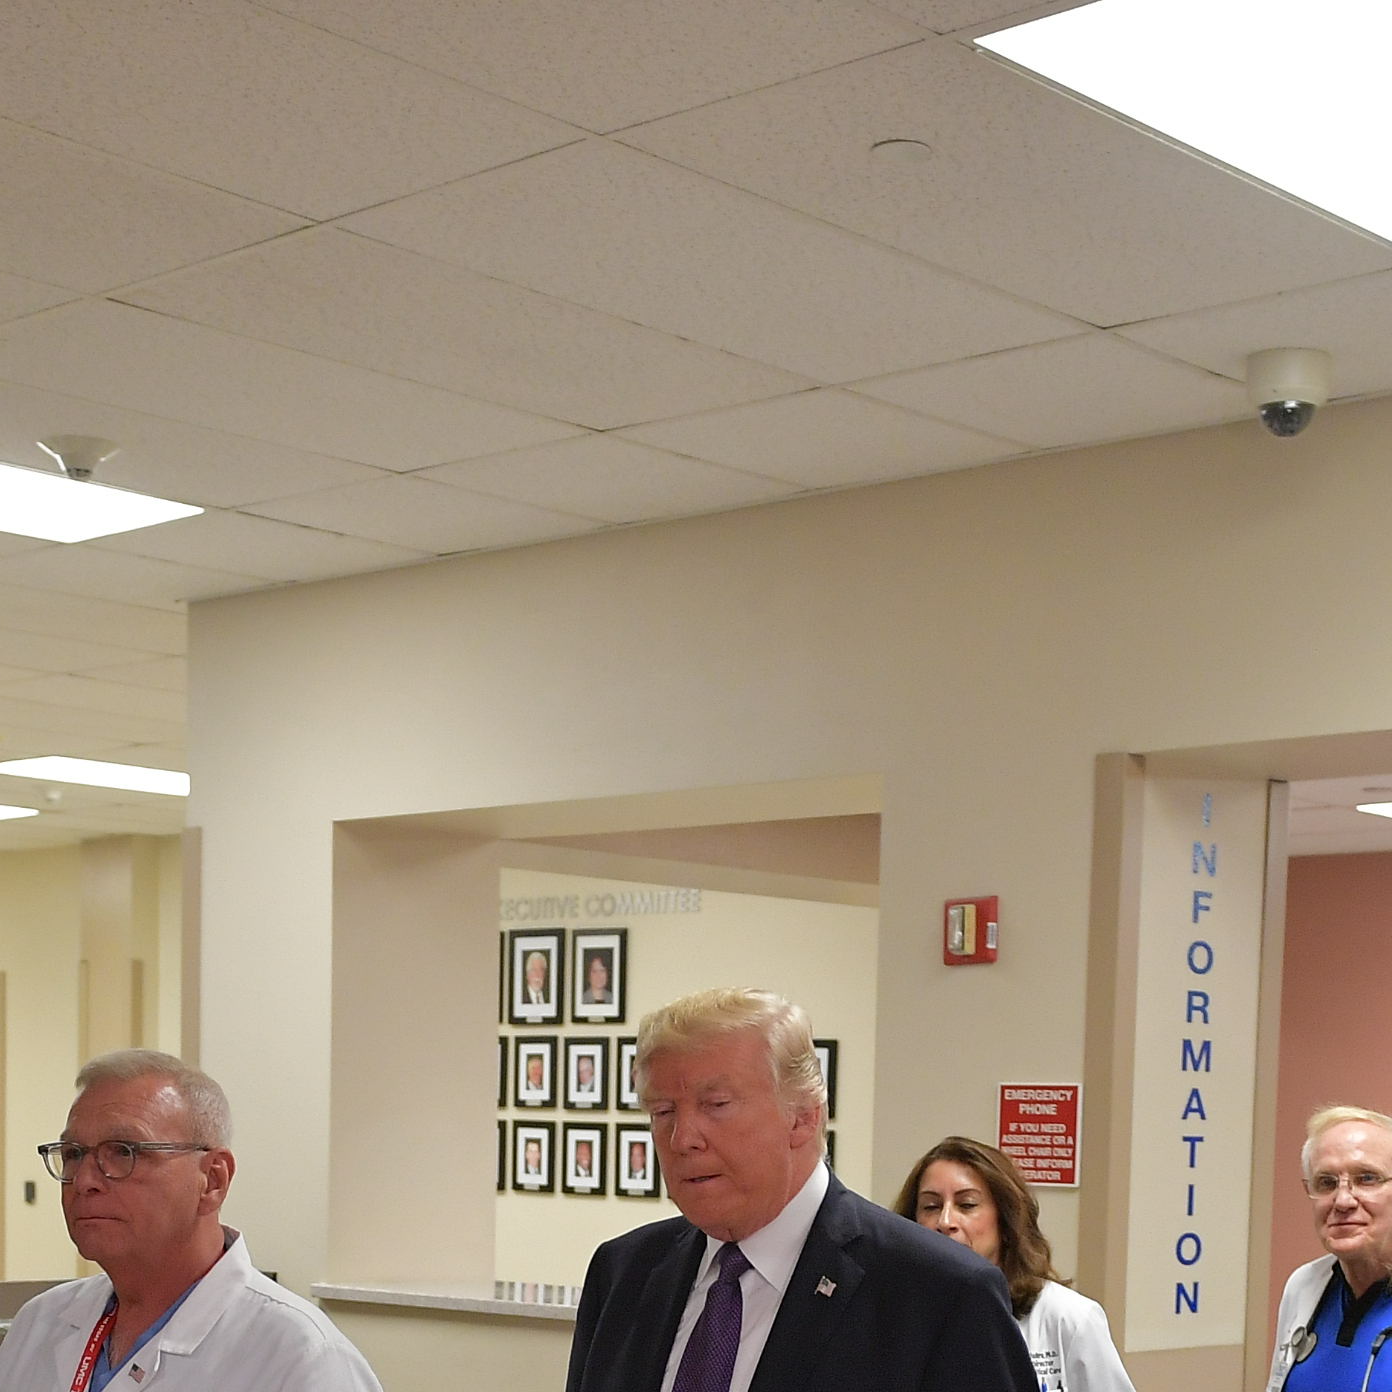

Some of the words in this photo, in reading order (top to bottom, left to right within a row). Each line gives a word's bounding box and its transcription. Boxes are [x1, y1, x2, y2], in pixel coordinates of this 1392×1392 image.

[1174, 792, 1218, 1315] INFORMATION
[1004, 1089, 1074, 1101] EMERGENCY
[1018, 1103, 1058, 1115] PHONE
[1020, 1123, 1040, 1133] YOU
[1040, 1124, 1067, 1133] NEED
[1053, 1136, 1066, 1145] OR
[1067, 1136, 1074, 1145] A
[1036, 1159, 1073, 1169] INFORM
[1023, 1170, 1061, 1180] ERATOR
[75, 1356, 92, 1386] UMC
